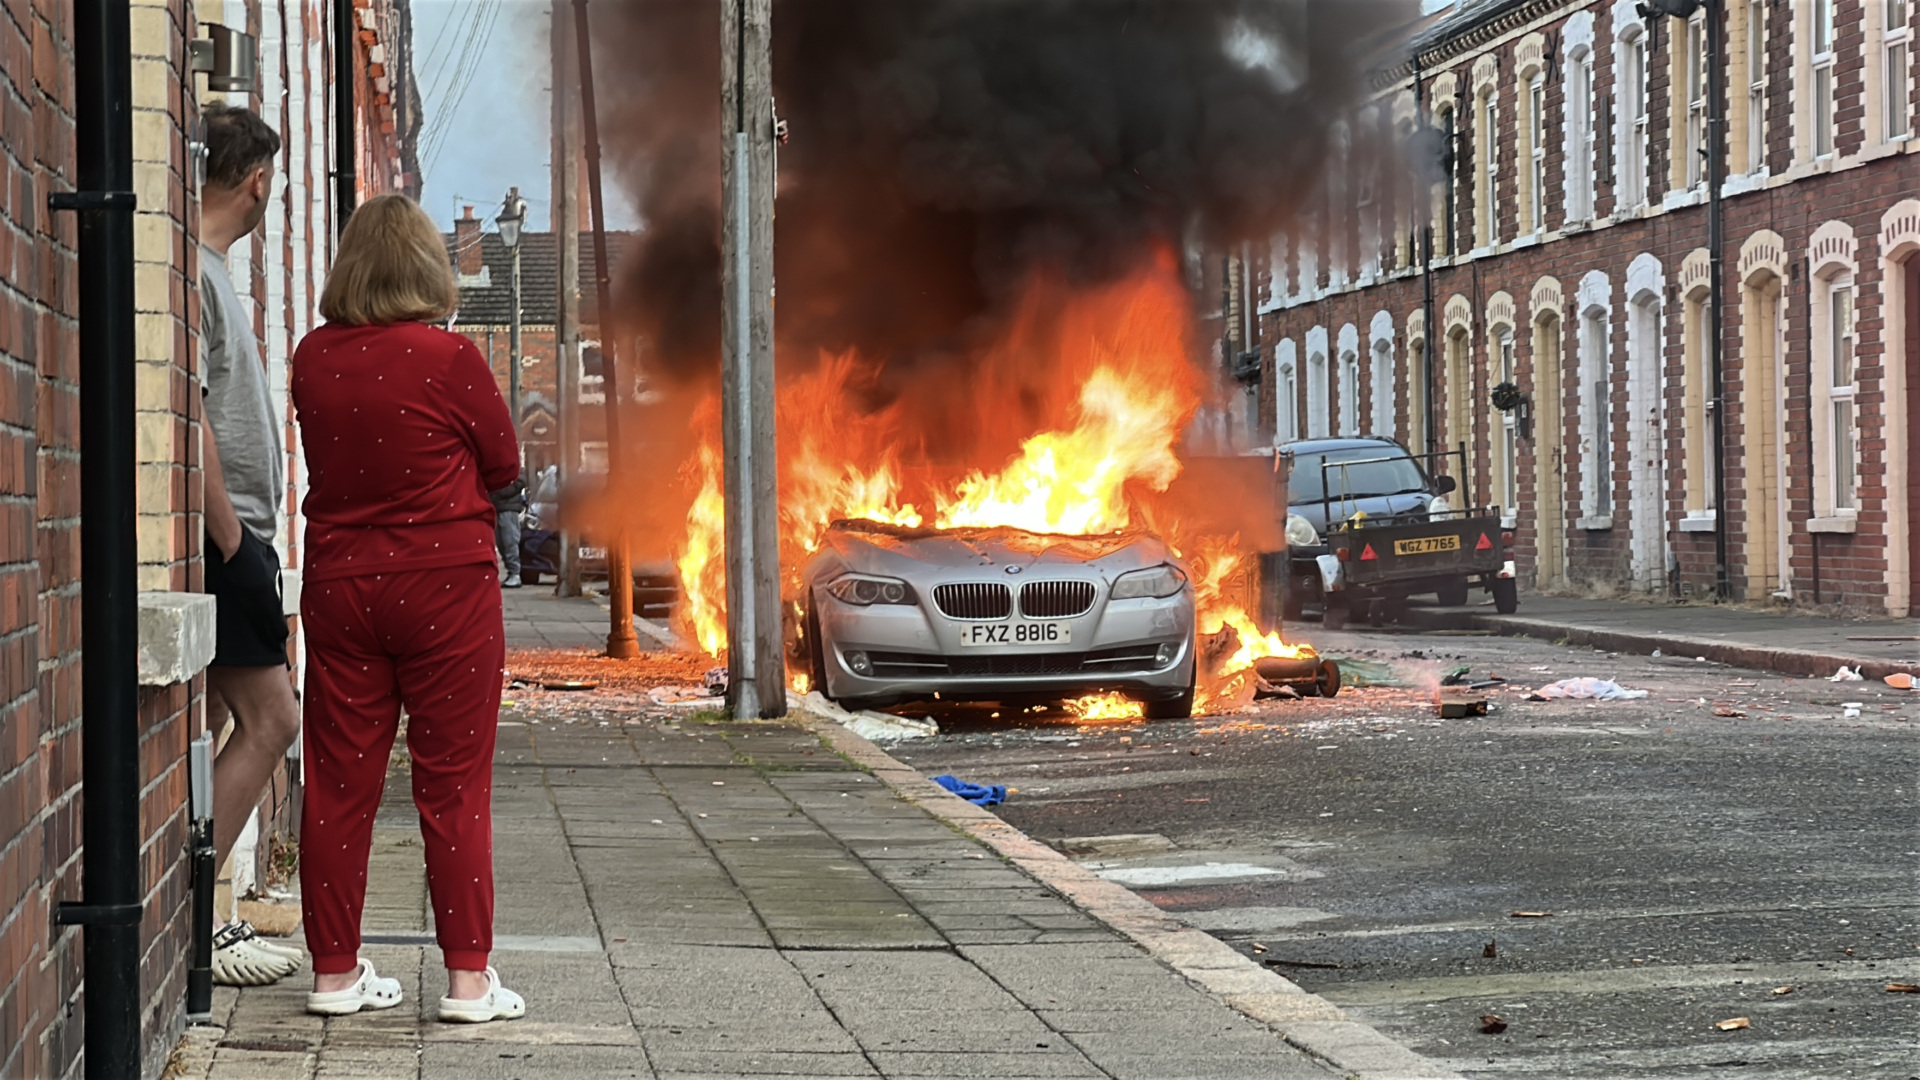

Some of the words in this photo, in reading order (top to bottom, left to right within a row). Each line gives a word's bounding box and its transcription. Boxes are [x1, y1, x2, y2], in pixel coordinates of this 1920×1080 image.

[1399, 540, 1423, 553] WGZ
[1424, 537, 1455, 551] 7765
[972, 624, 1010, 643] FXZ
[1015, 623, 1058, 641] 8816
